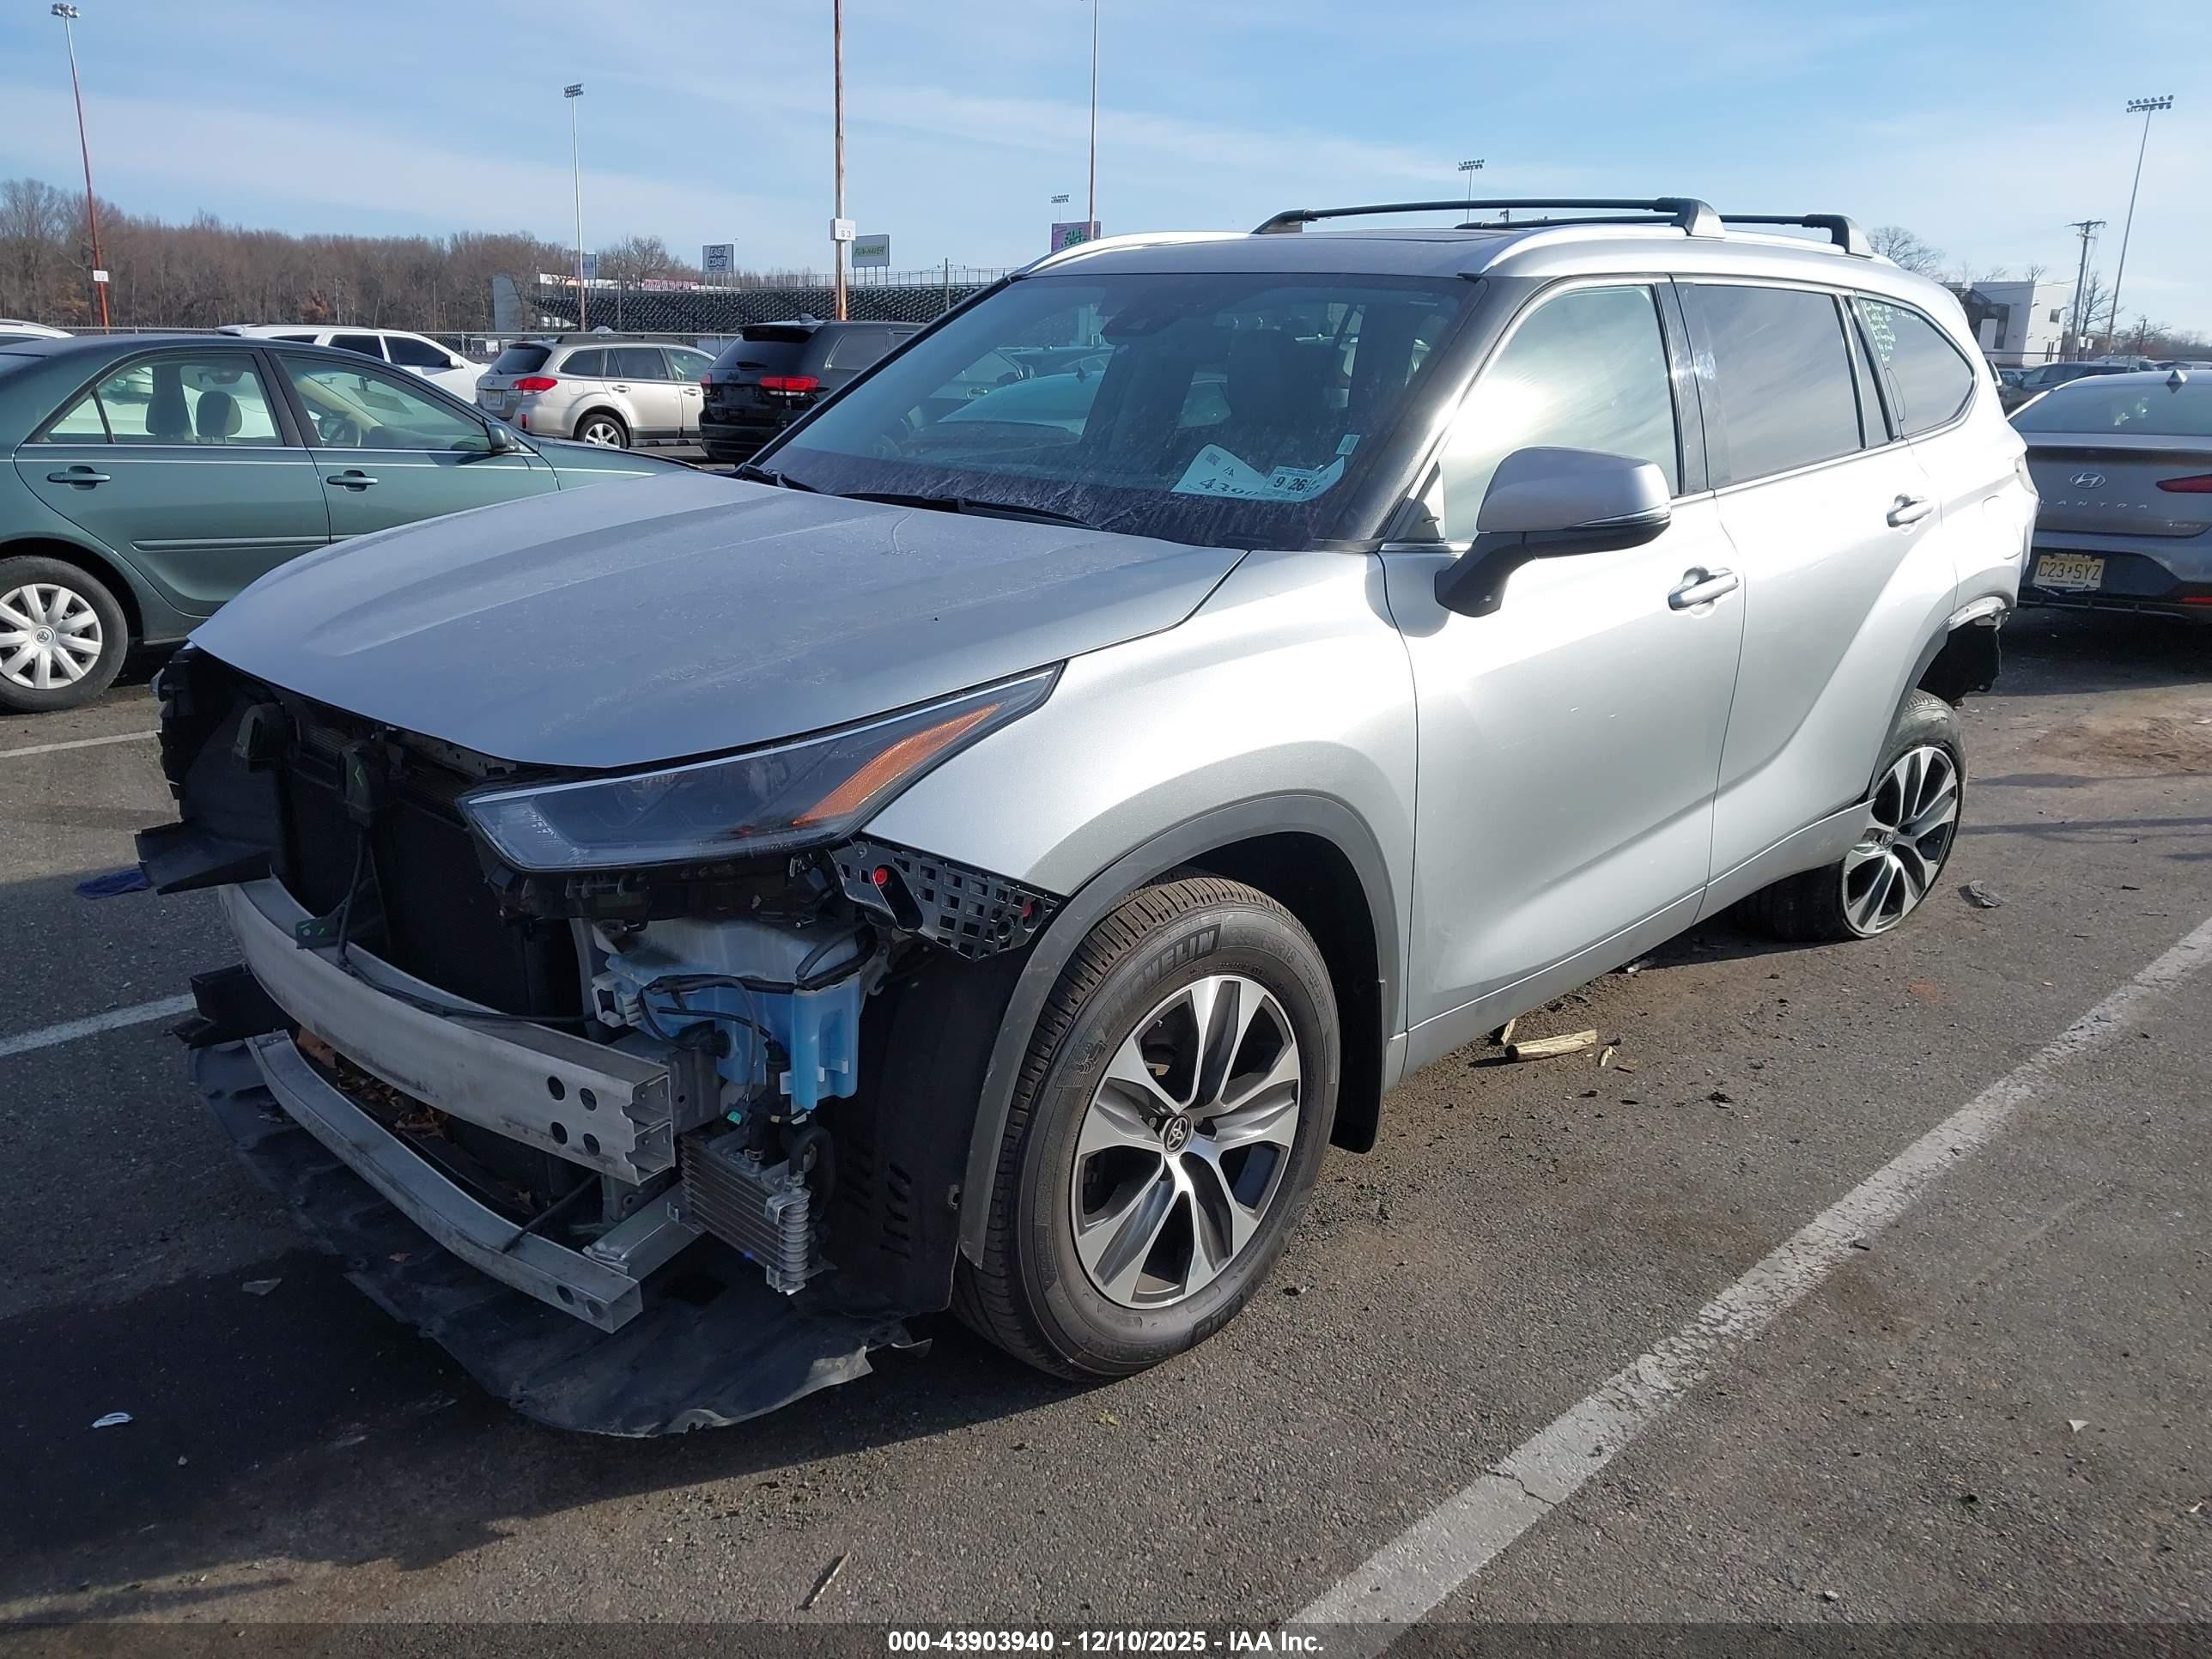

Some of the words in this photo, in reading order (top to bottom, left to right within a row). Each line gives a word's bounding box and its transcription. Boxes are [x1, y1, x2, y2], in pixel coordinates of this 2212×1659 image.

[710, 246, 725, 256] EAST
[708, 256, 727, 267] COAST
[1273, 476, 1285, 488] 9
[1287, 477, 1308, 492] 26
[2040, 500, 2148, 509] LANTRA
